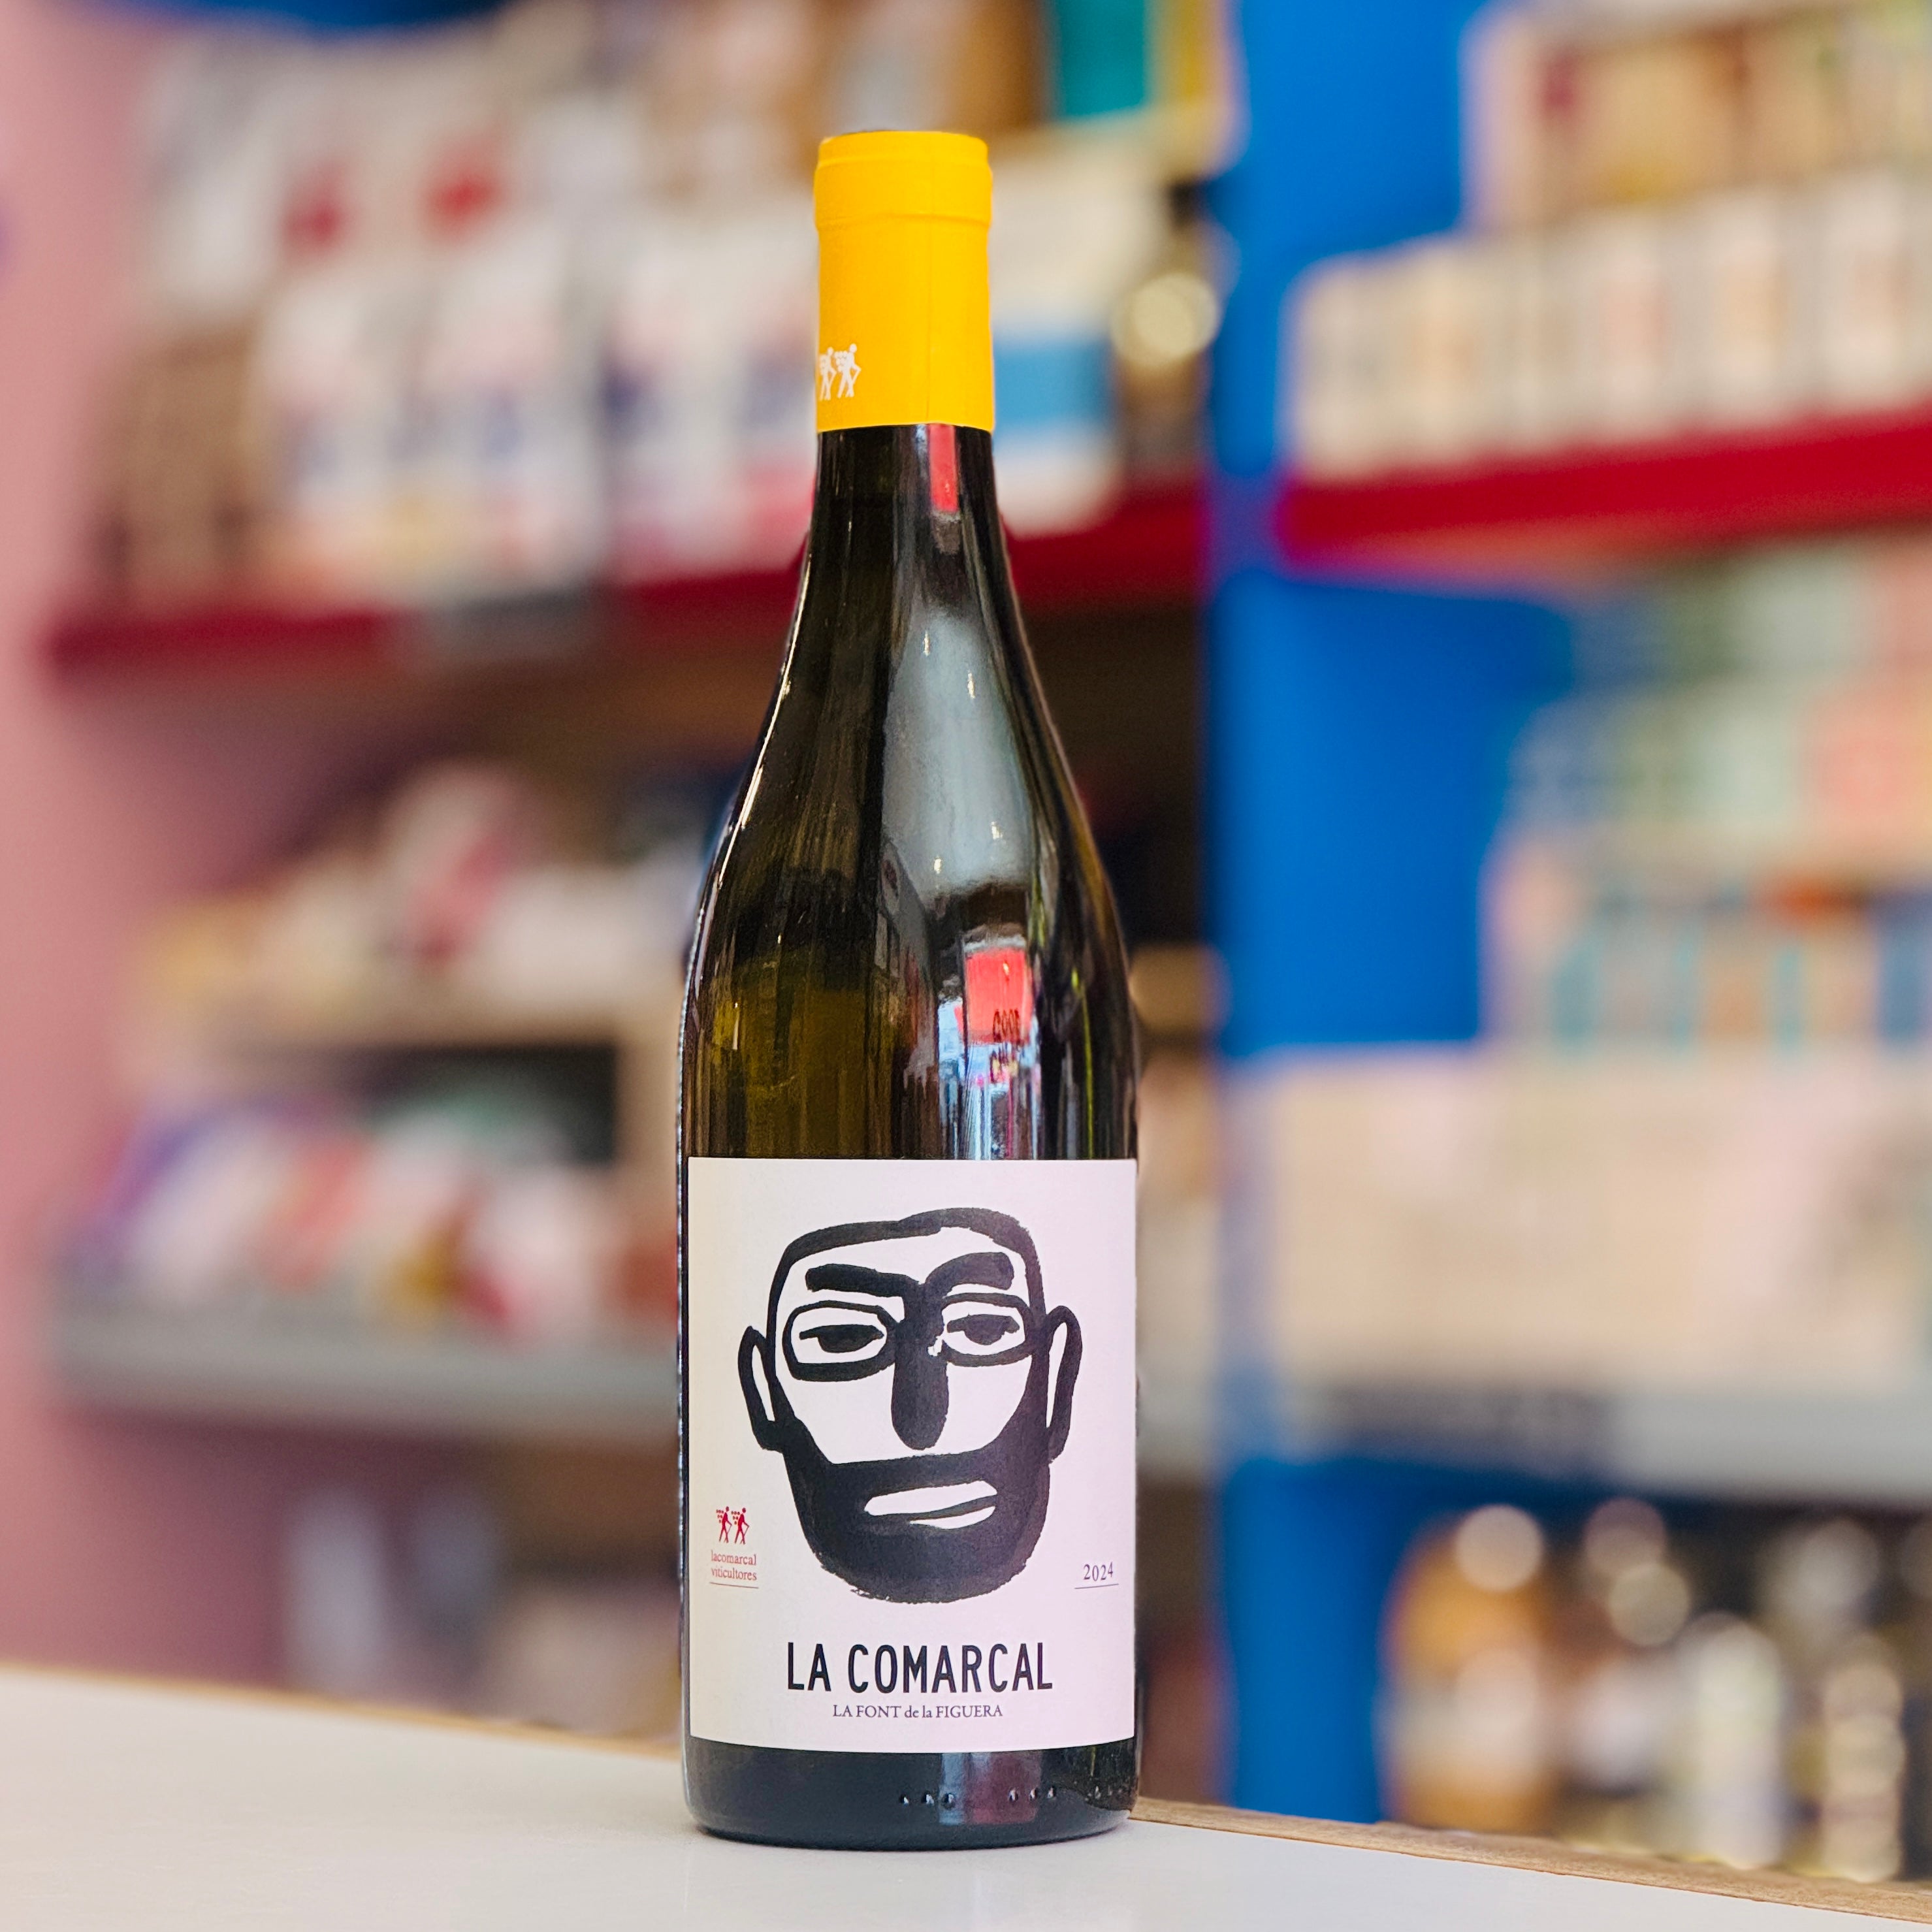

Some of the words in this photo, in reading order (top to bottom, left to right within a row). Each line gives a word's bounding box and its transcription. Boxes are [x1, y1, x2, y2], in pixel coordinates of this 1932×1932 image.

[711, 1550, 757, 1566] lacomarcal
[711, 1566, 757, 1581] viticultores
[1083, 1562, 1114, 1581] 2024
[787, 1641, 831, 1692] LA
[847, 1642, 1053, 1694] COMARCAL
[832, 1704, 853, 1718] LA
[856, 1705, 902, 1718] FONT
[904, 1705, 920, 1718] de
[922, 1705, 933, 1718] la
[935, 1705, 1003, 1718] FIGUERA
